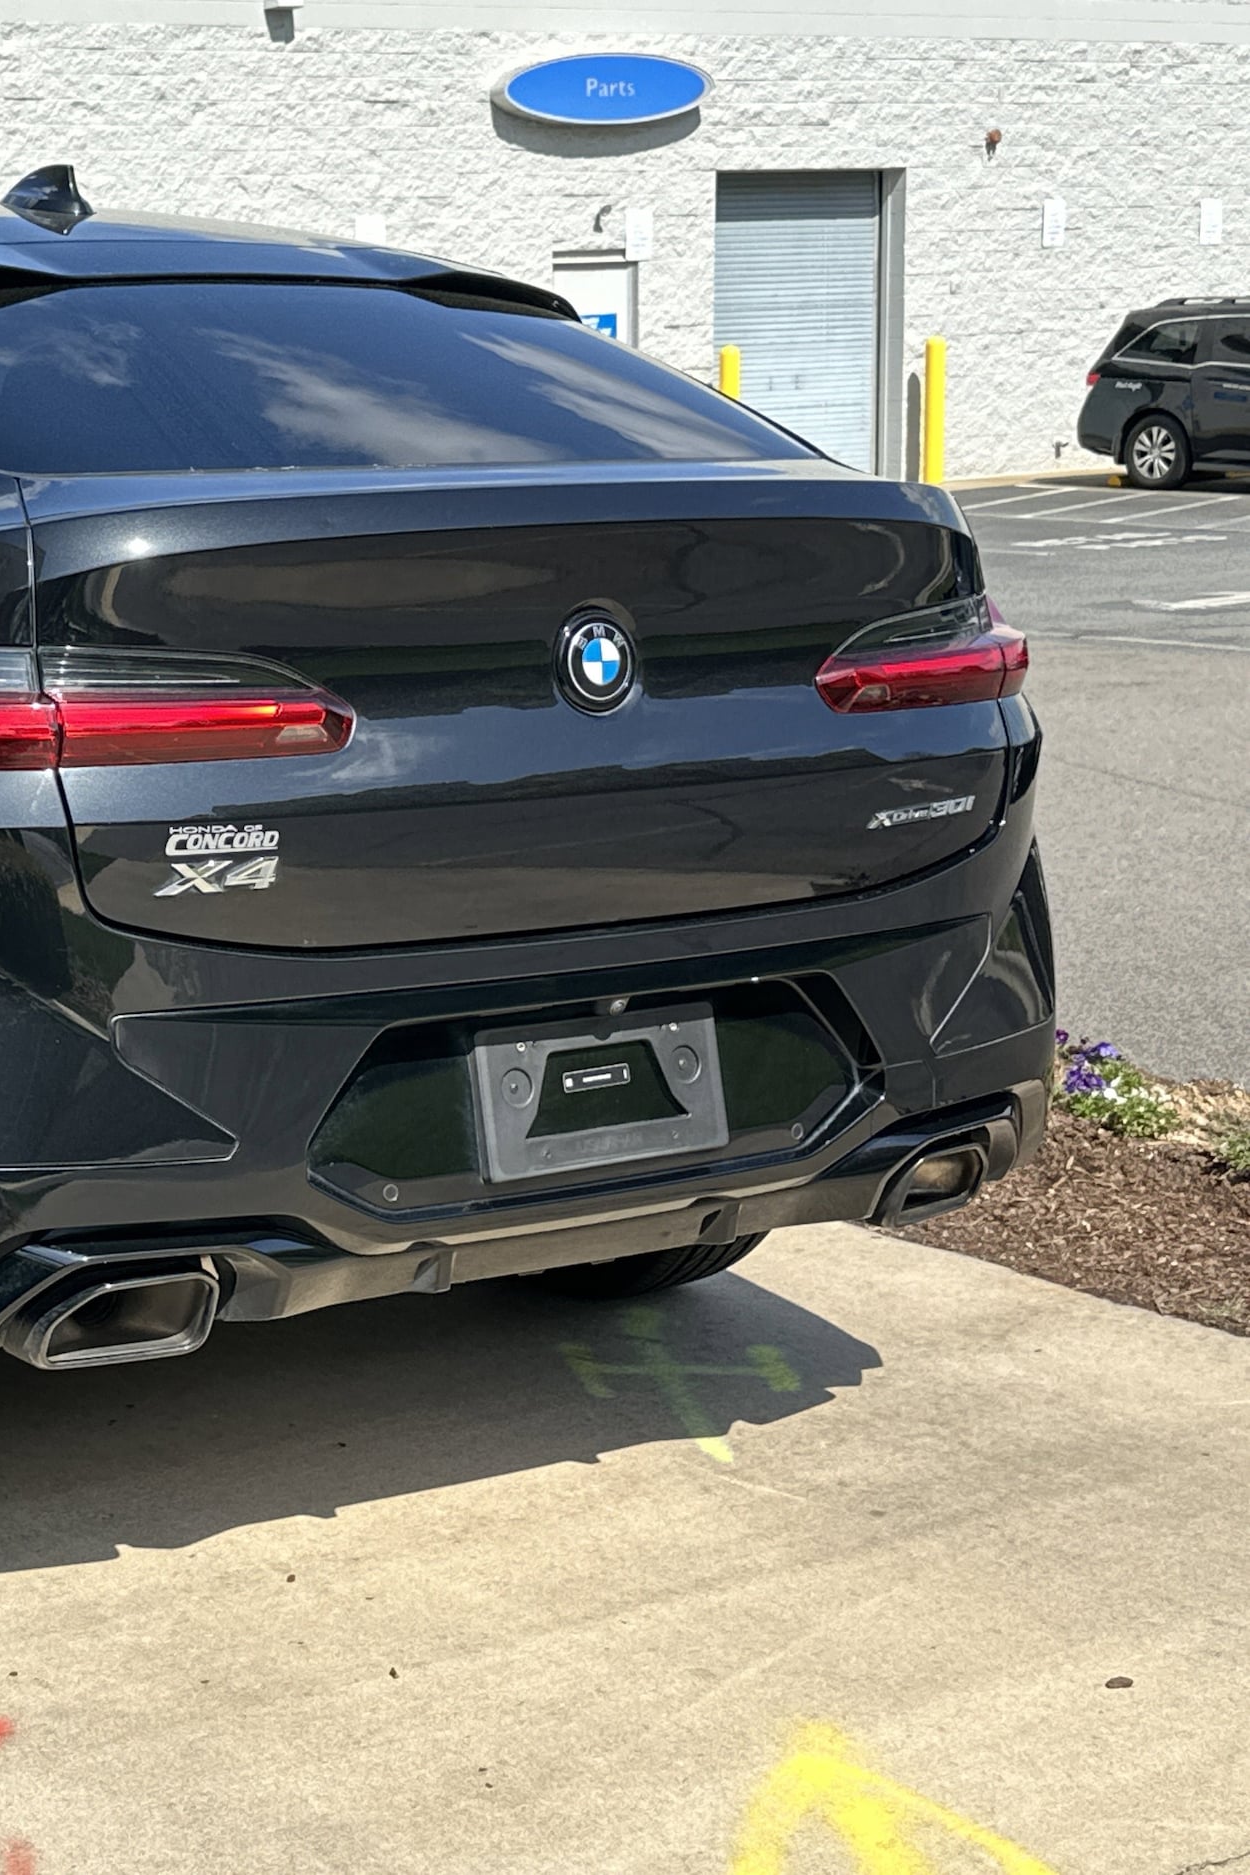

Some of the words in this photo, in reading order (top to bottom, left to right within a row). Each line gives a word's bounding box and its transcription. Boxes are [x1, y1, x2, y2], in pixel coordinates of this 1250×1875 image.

[585, 77, 636, 97] Parts
[169, 824, 238, 834] HONDA
[243, 824, 263, 832] OF
[165, 830, 280, 856] CONCORD
[153, 856, 279, 897] X4
